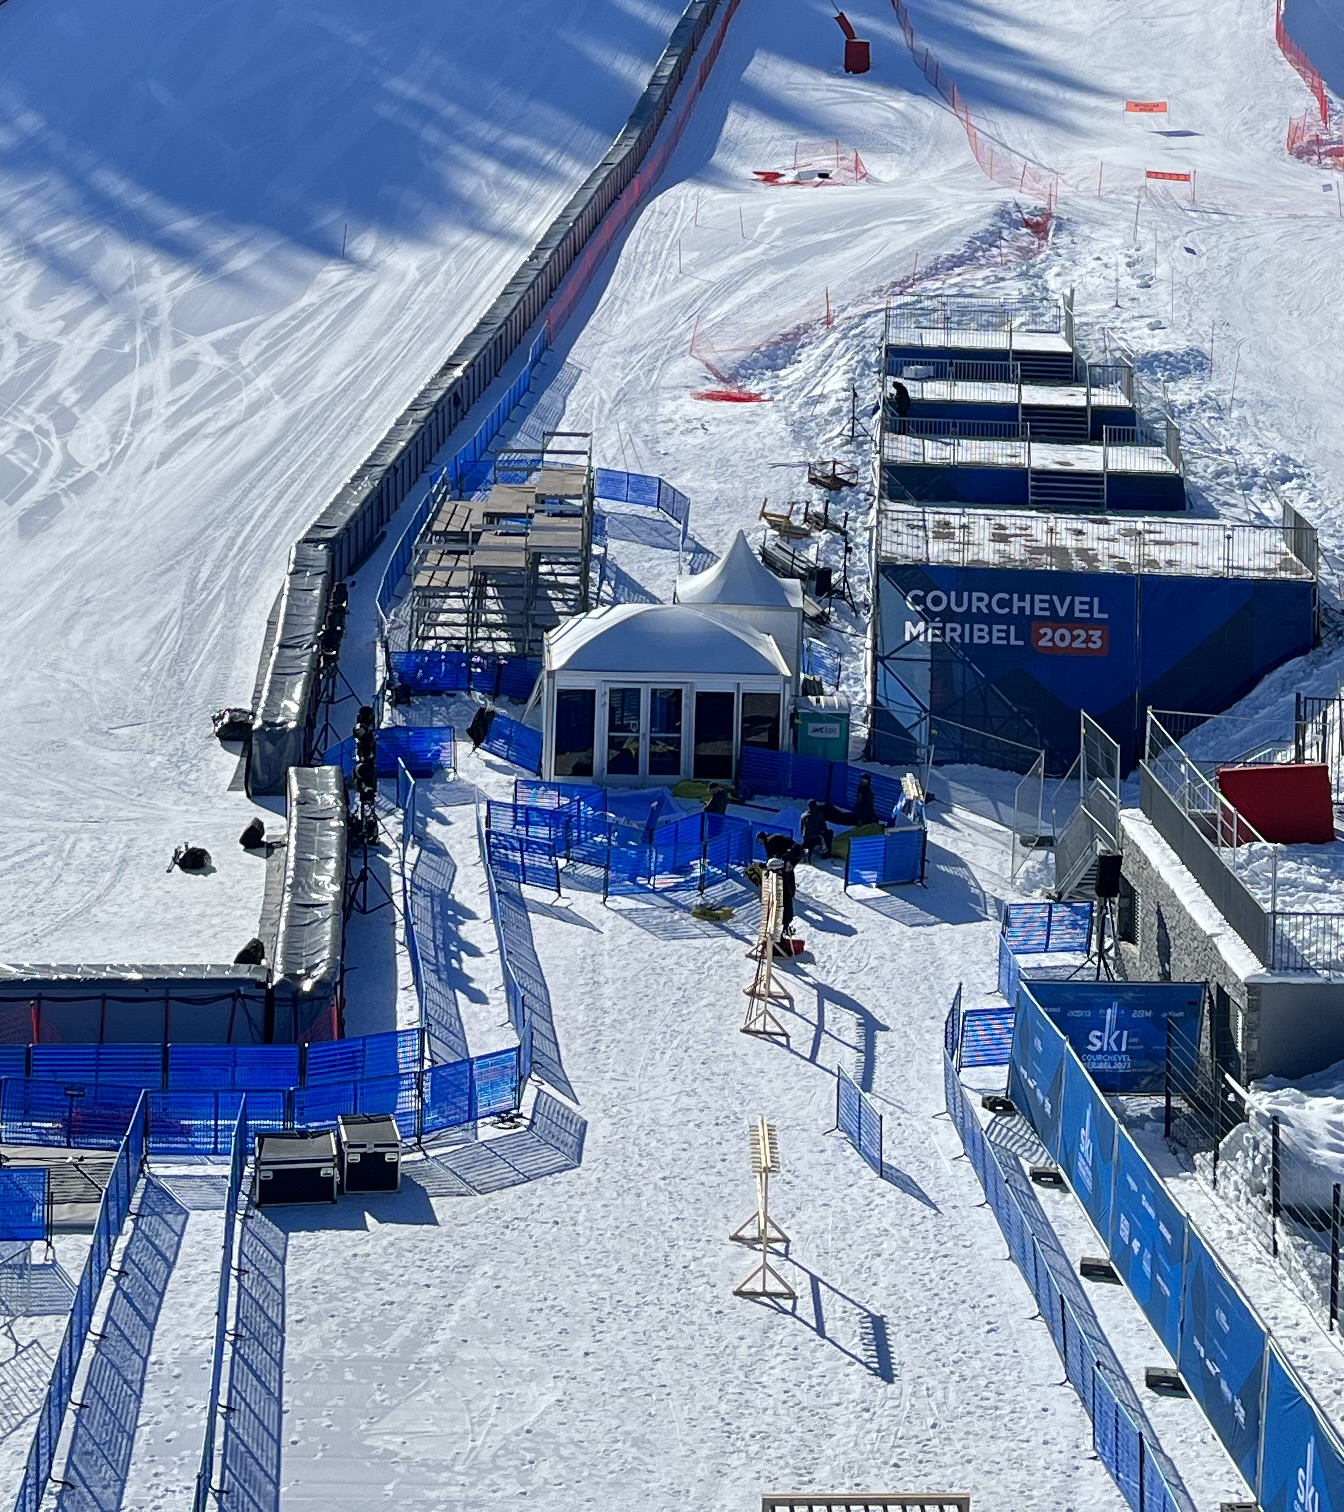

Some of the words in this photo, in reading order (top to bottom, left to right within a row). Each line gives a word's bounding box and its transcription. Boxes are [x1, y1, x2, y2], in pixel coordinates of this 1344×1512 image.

[906, 589, 1109, 619] COURCHEVEL
[904, 617, 1025, 646] MÉRIBEL
[1037, 626, 1103, 649] 2023
